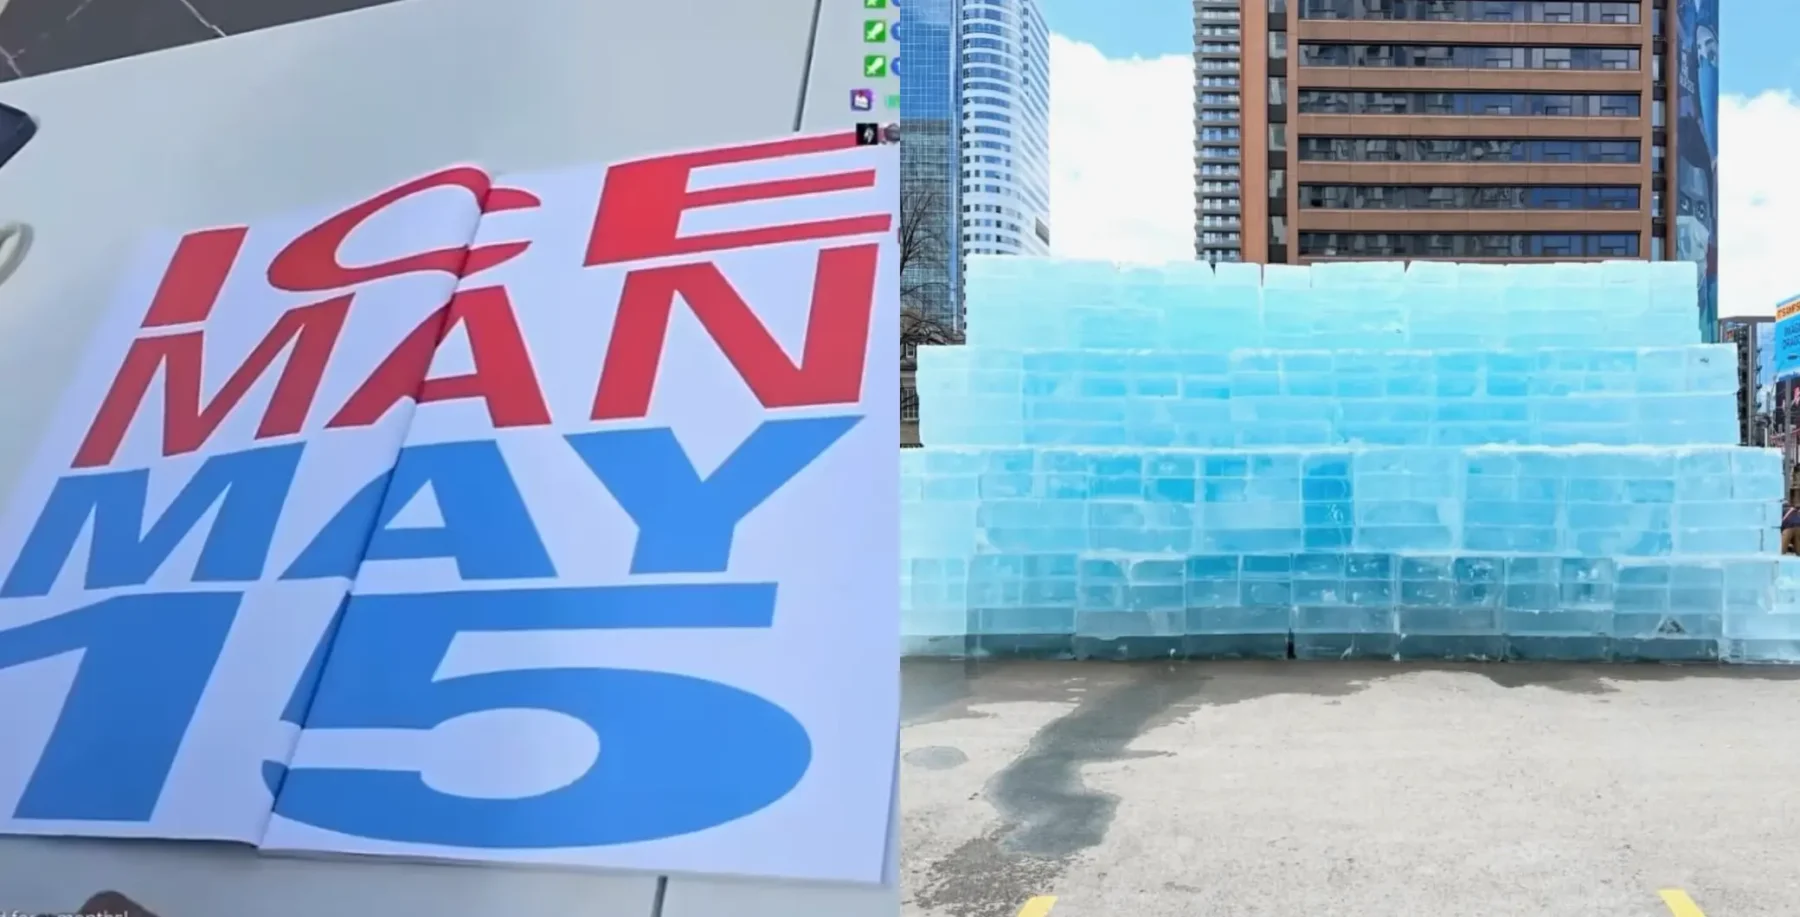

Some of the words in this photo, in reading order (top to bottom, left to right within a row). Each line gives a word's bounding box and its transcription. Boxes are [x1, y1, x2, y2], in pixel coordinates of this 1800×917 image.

[141, 131, 892, 328] ICE
[71, 243, 880, 468] MAN
[0, 414, 865, 598] MAY
[0, 582, 813, 848] 15
